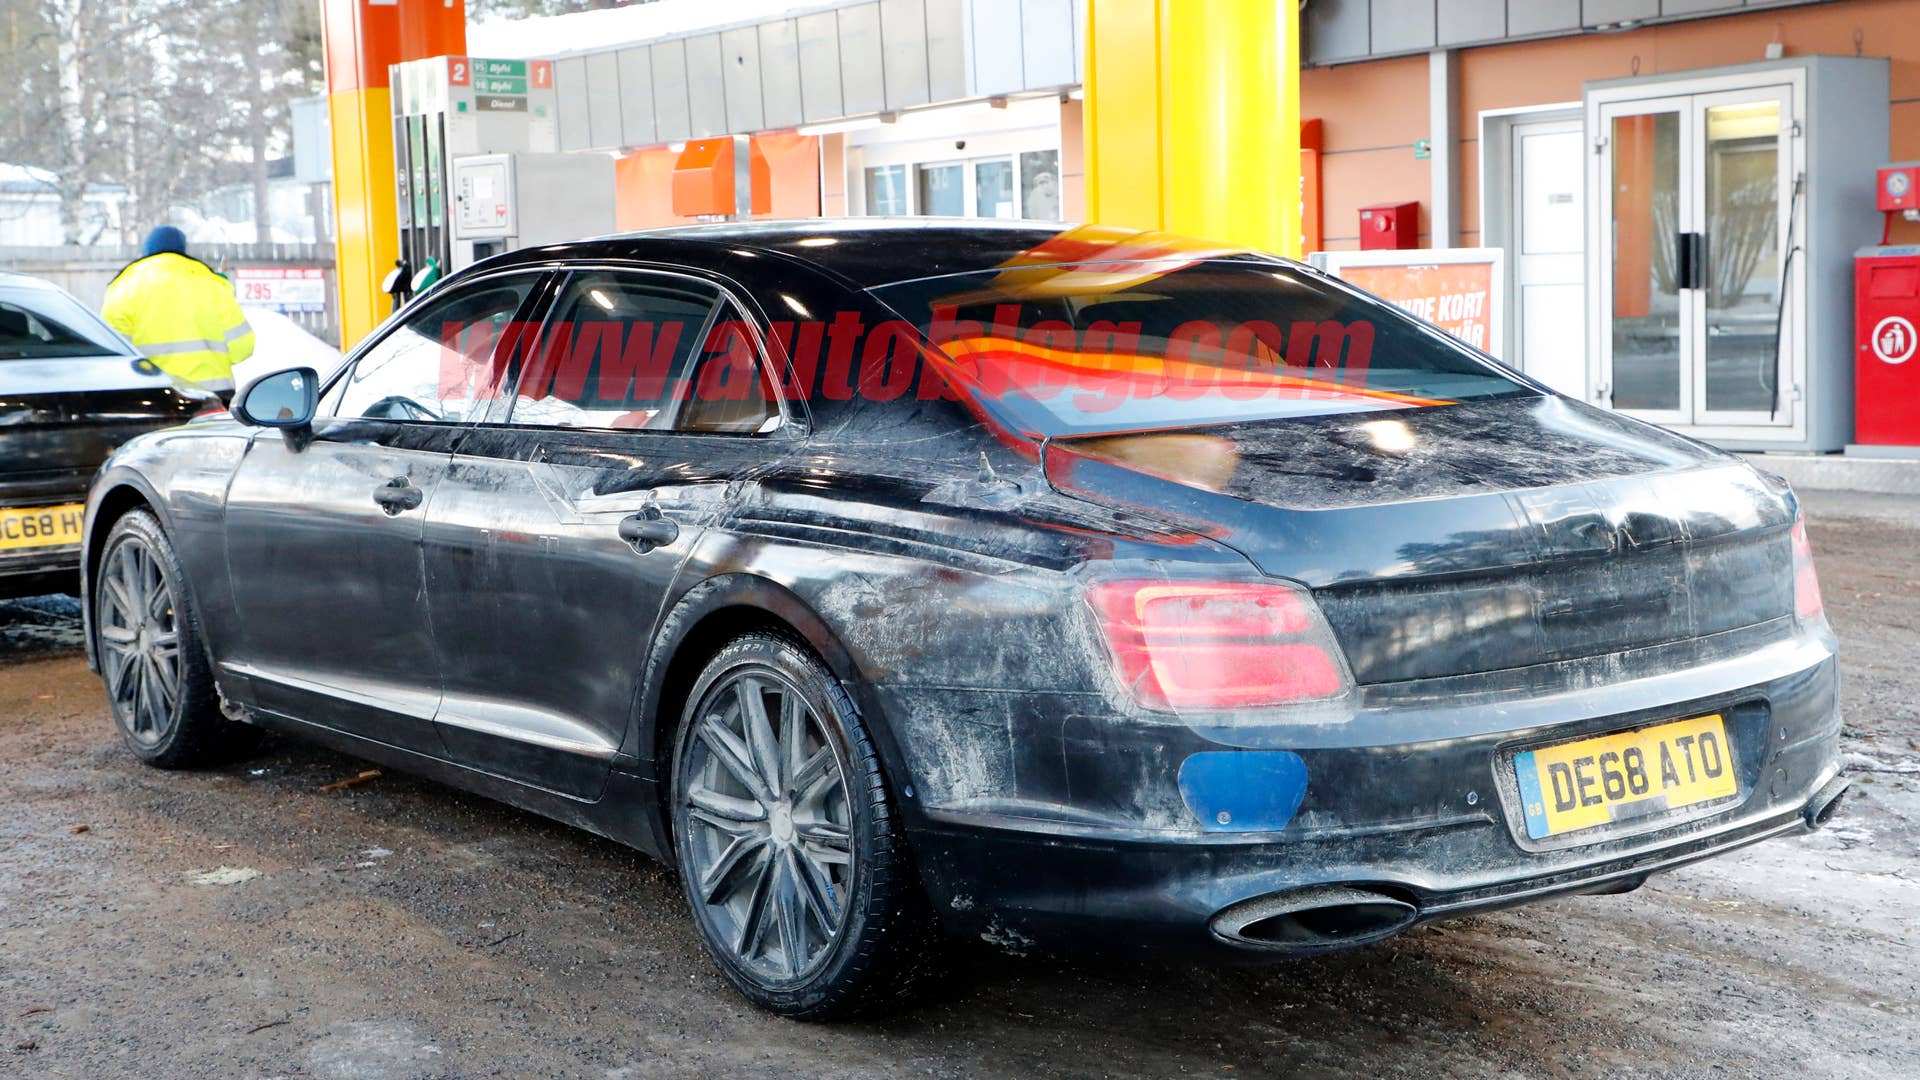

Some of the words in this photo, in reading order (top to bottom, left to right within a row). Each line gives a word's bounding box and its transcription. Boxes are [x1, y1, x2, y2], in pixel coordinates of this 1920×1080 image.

[453, 63, 465, 81] 2
[538, 66, 545, 84] 1
[490, 100, 515, 108] Diesel
[245, 283, 271, 300] 295
[1438, 292, 1486, 322] KORT
[0, 514, 54, 540] C68
[1547, 747, 1649, 813] DE68
[1659, 731, 1723, 789] ATO
